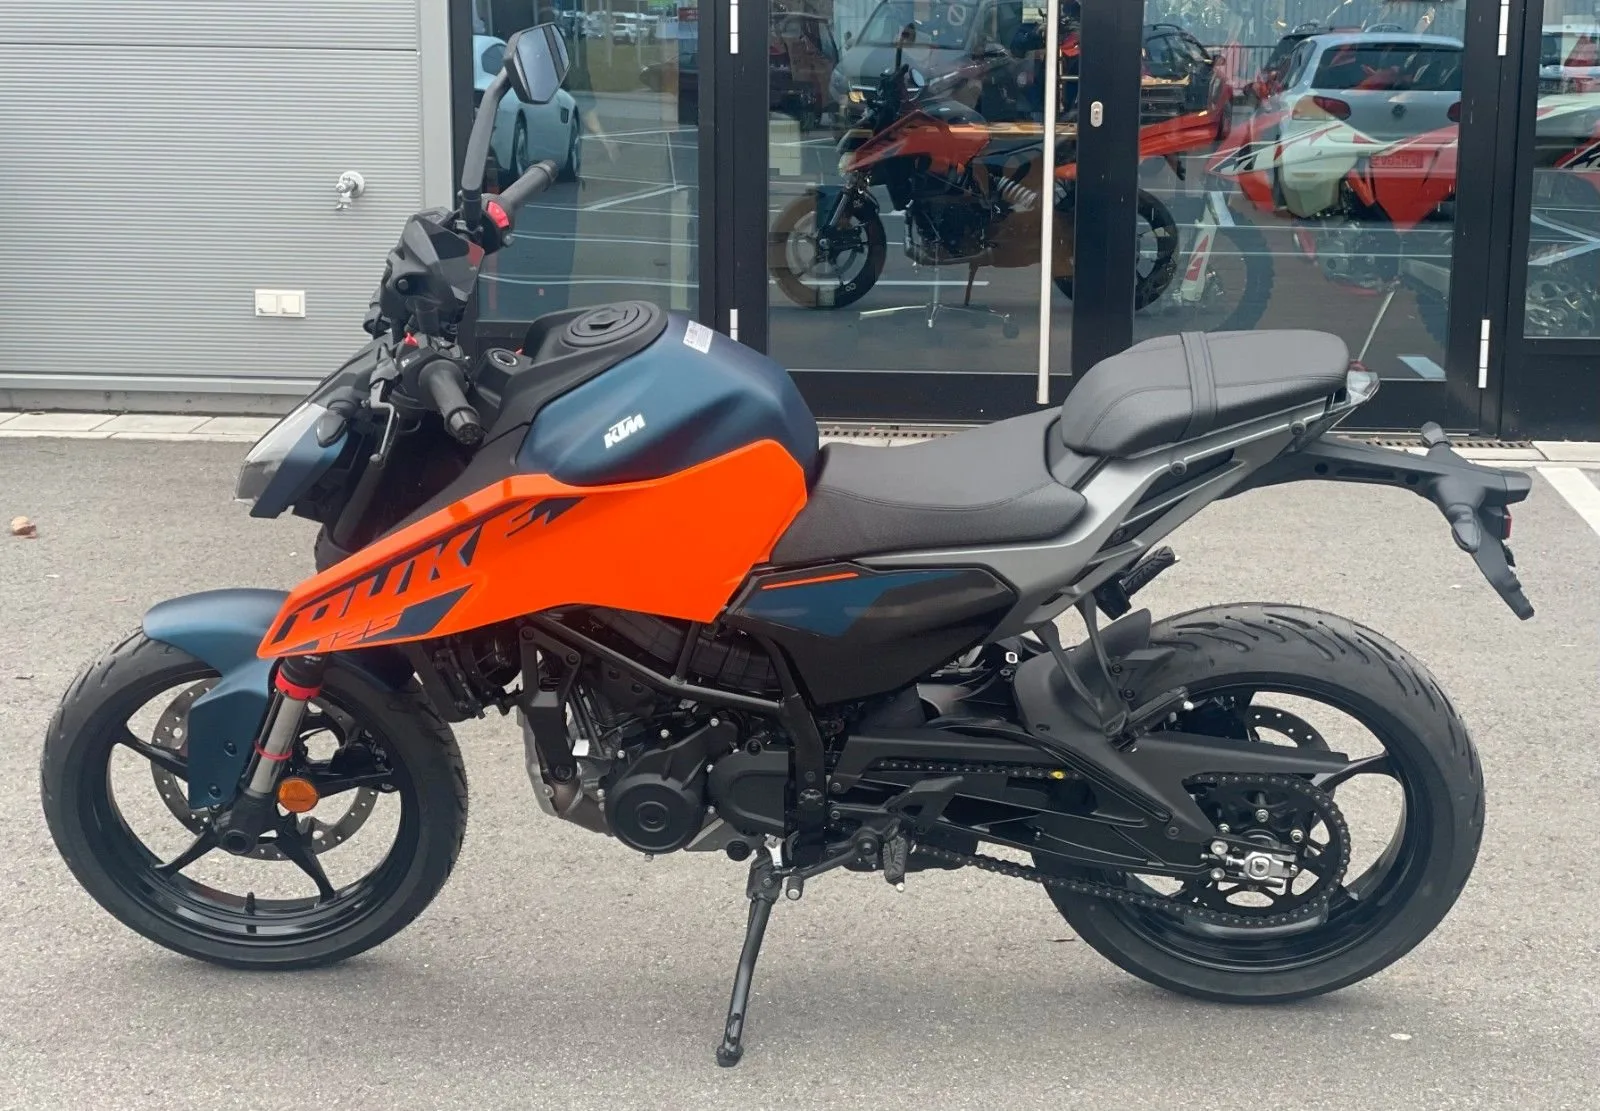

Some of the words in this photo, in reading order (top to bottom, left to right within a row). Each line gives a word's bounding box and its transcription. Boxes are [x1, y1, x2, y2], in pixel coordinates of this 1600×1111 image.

[604, 413, 646, 449] KTM
[273, 496, 578, 645] DUKE
[314, 610, 403, 651] 125
